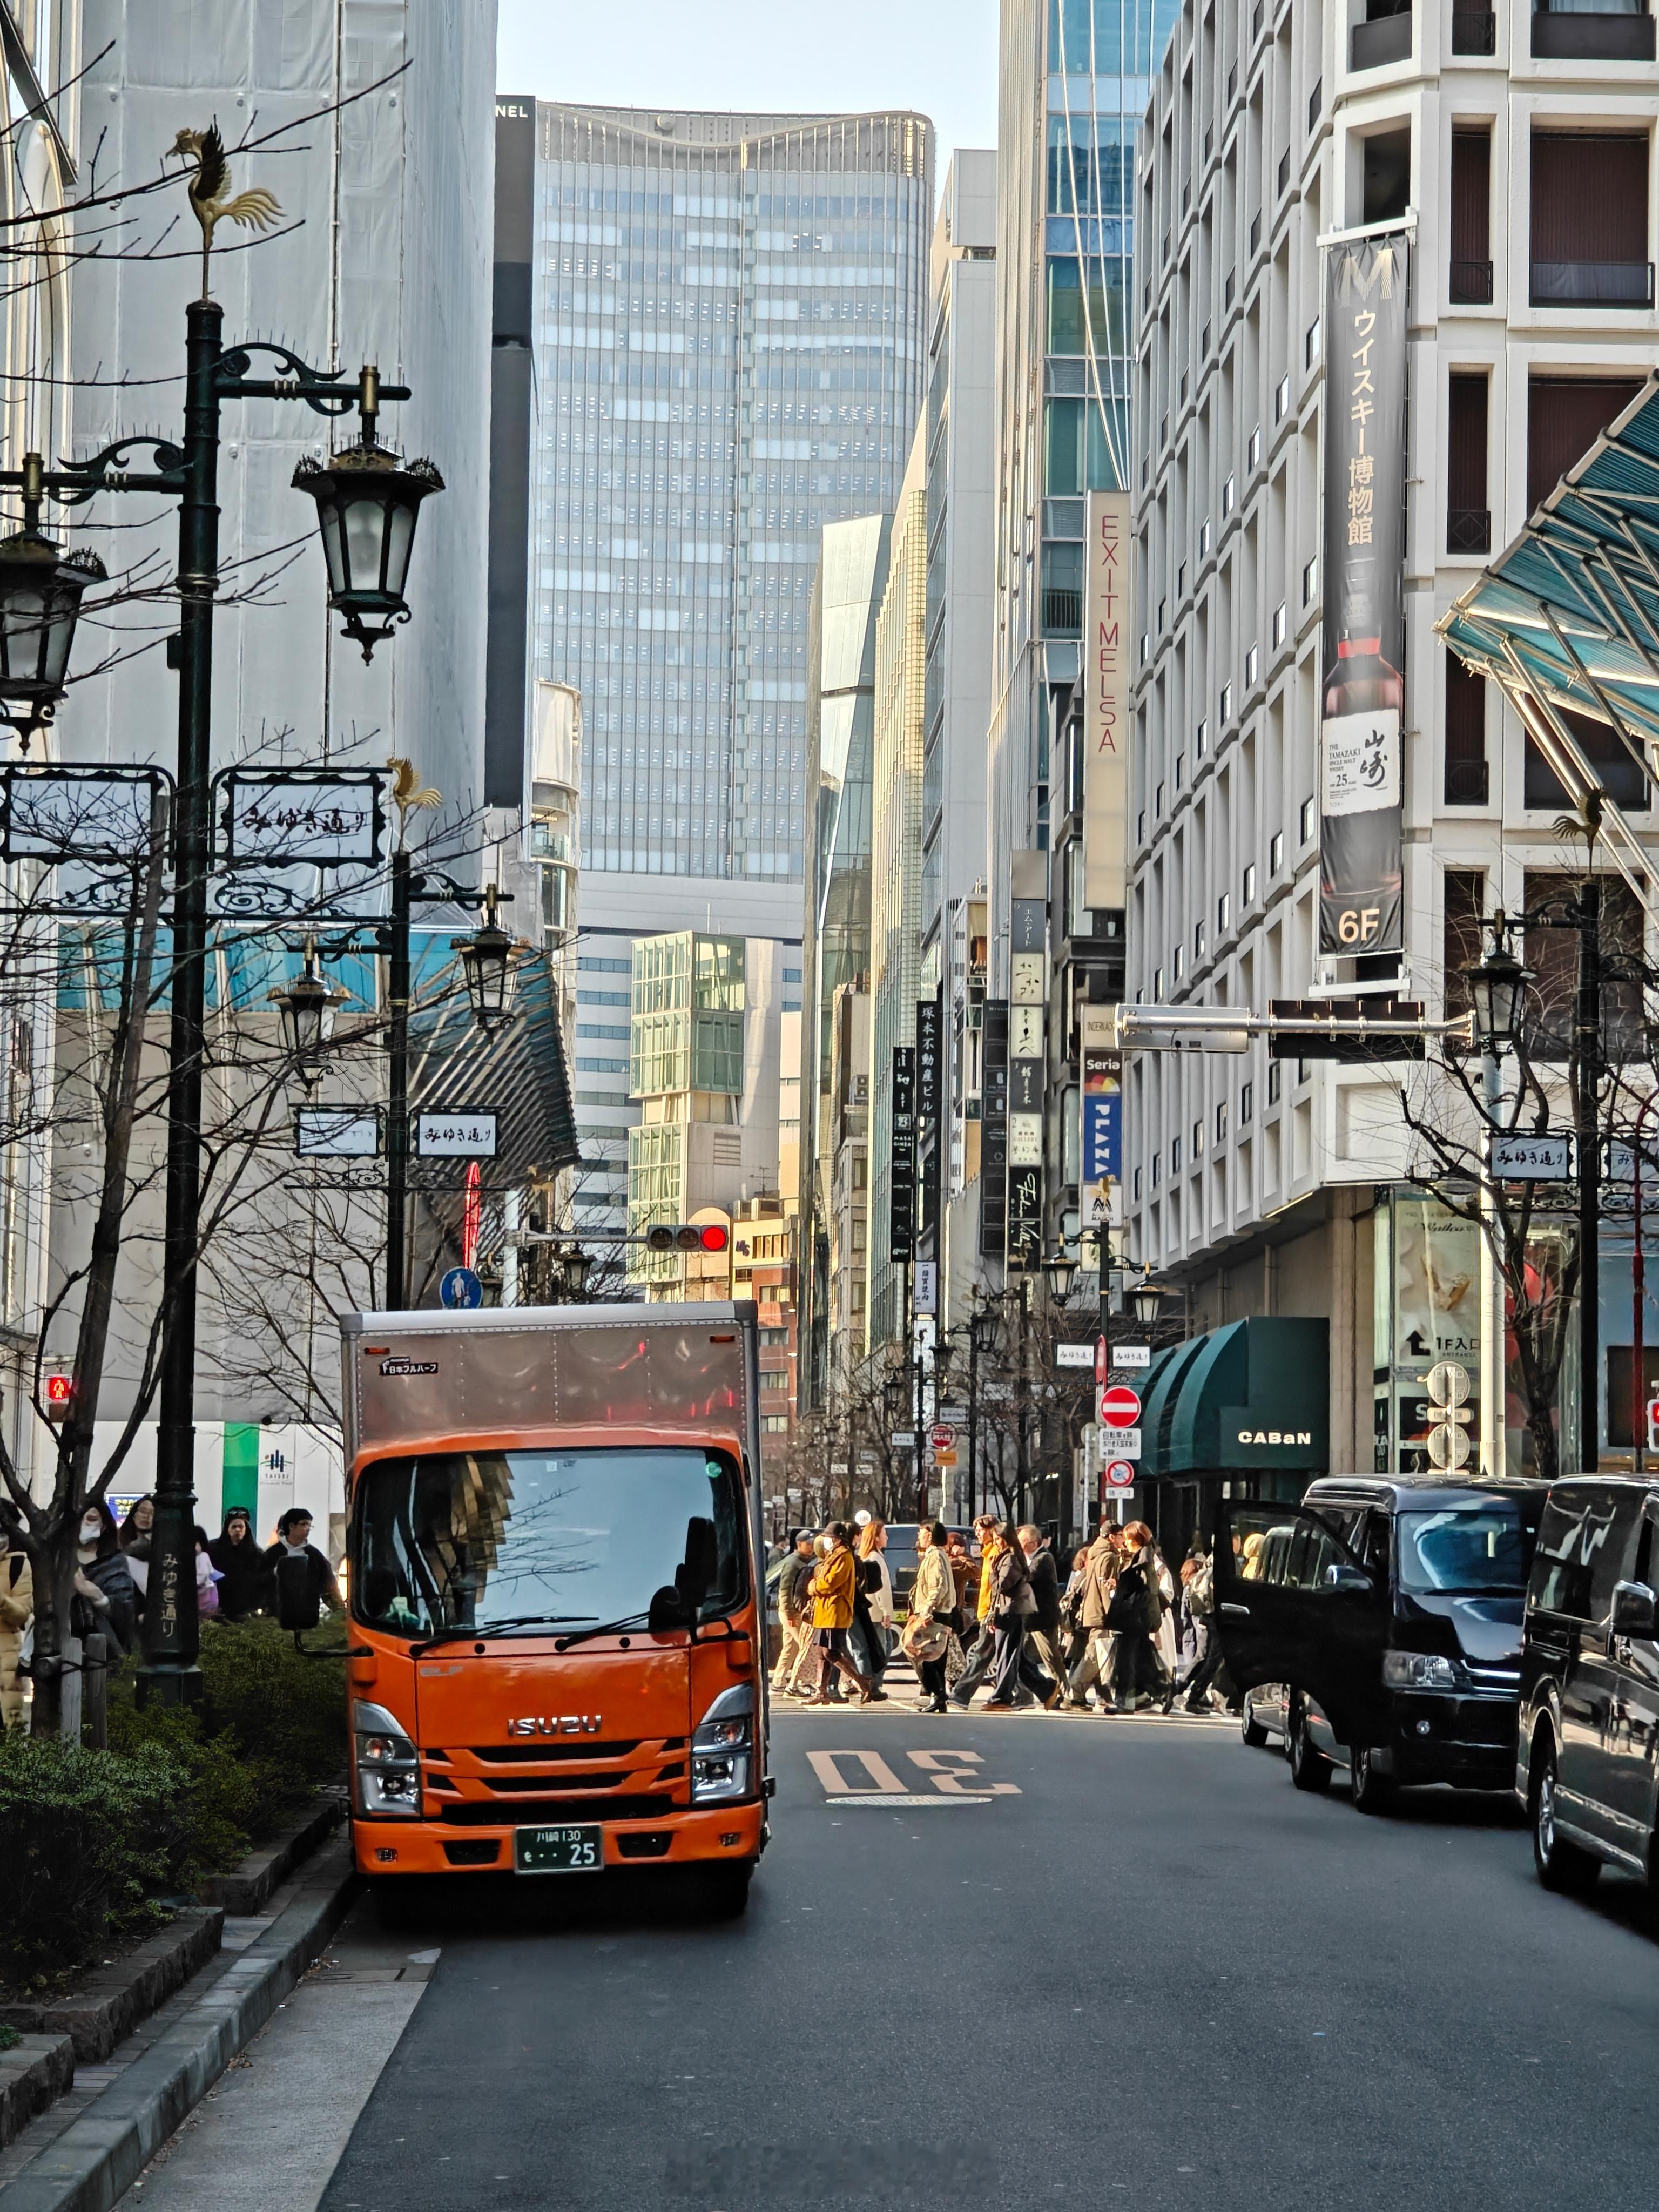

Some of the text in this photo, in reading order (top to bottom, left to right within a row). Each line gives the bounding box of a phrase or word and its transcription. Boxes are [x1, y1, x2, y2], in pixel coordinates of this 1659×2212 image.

[1348, 309, 1376, 546] ウイスキー博物館
[1336, 773, 1348, 787] 25
[1338, 908, 1380, 943] 6F
[921, 1006, 935, 1112] 塚本不動産ビル
[1087, 1058, 1121, 1070] Seria
[424, 1128, 491, 1142] みゆき通り
[1095, 1104, 1110, 1175] PLAZA
[1496, 1149, 1563, 1165] みゆき通り
[389, 1364, 436, 1374] 日本フルハーフ
[1238, 1431, 1311, 1445] CABaN
[161, 1553, 178, 1637] みゆき通り
[508, 1715, 602, 1737] ISUZU
[537, 1830, 581, 1843] 川崎 130
